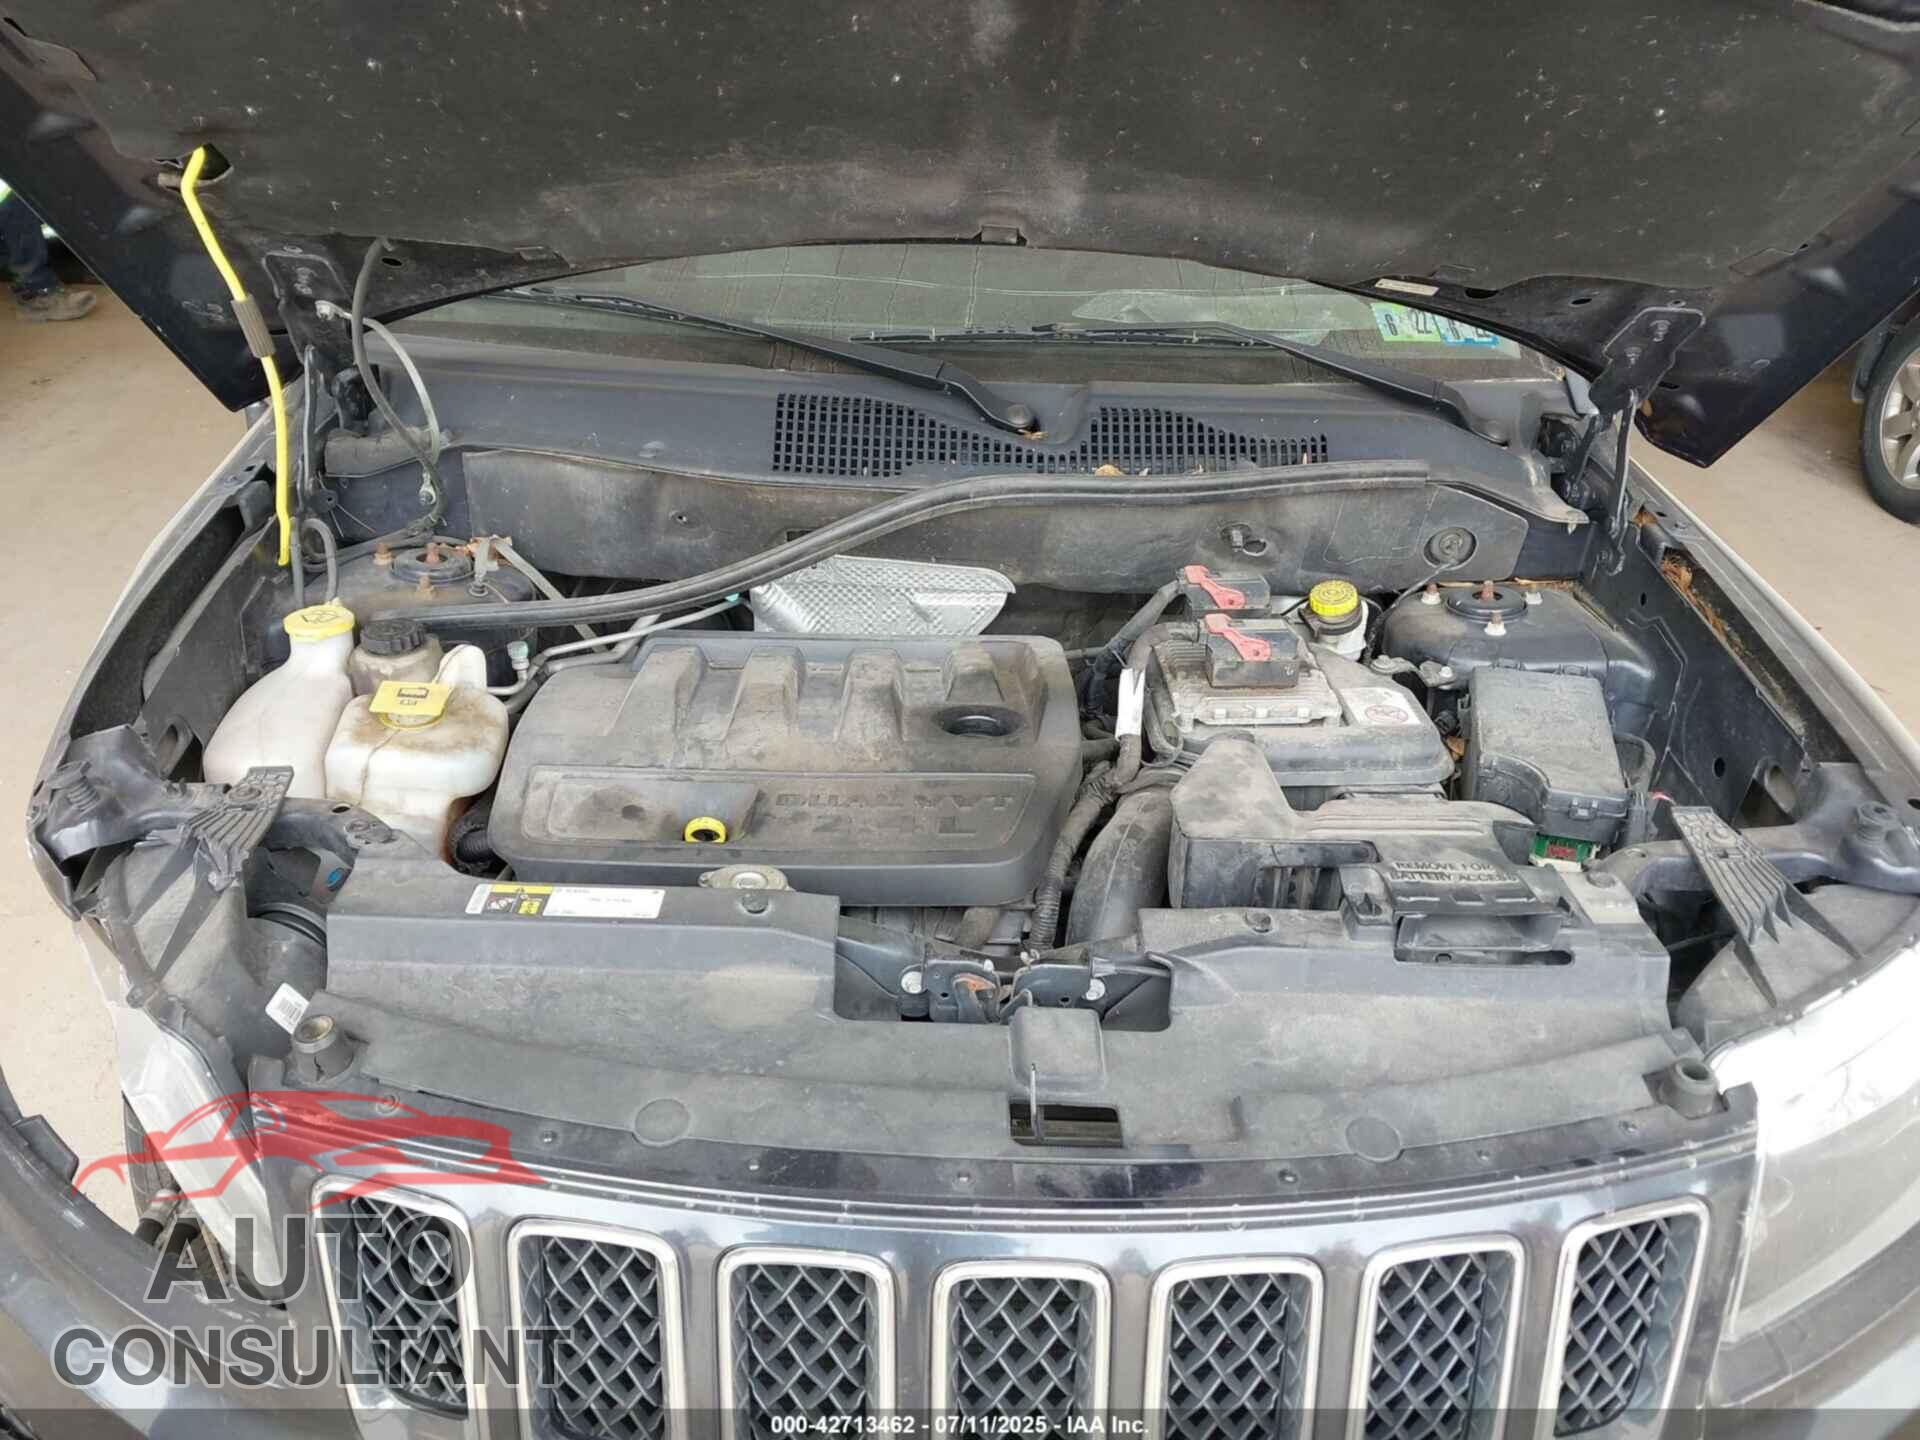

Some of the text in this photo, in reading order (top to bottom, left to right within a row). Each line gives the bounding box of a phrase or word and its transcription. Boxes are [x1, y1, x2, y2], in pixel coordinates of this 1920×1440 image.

[776, 792, 1016, 811] DUAL VVT
[1393, 861, 1496, 872] REMOVE FOR
[1390, 871, 1519, 883] BATTERY ACCESS
